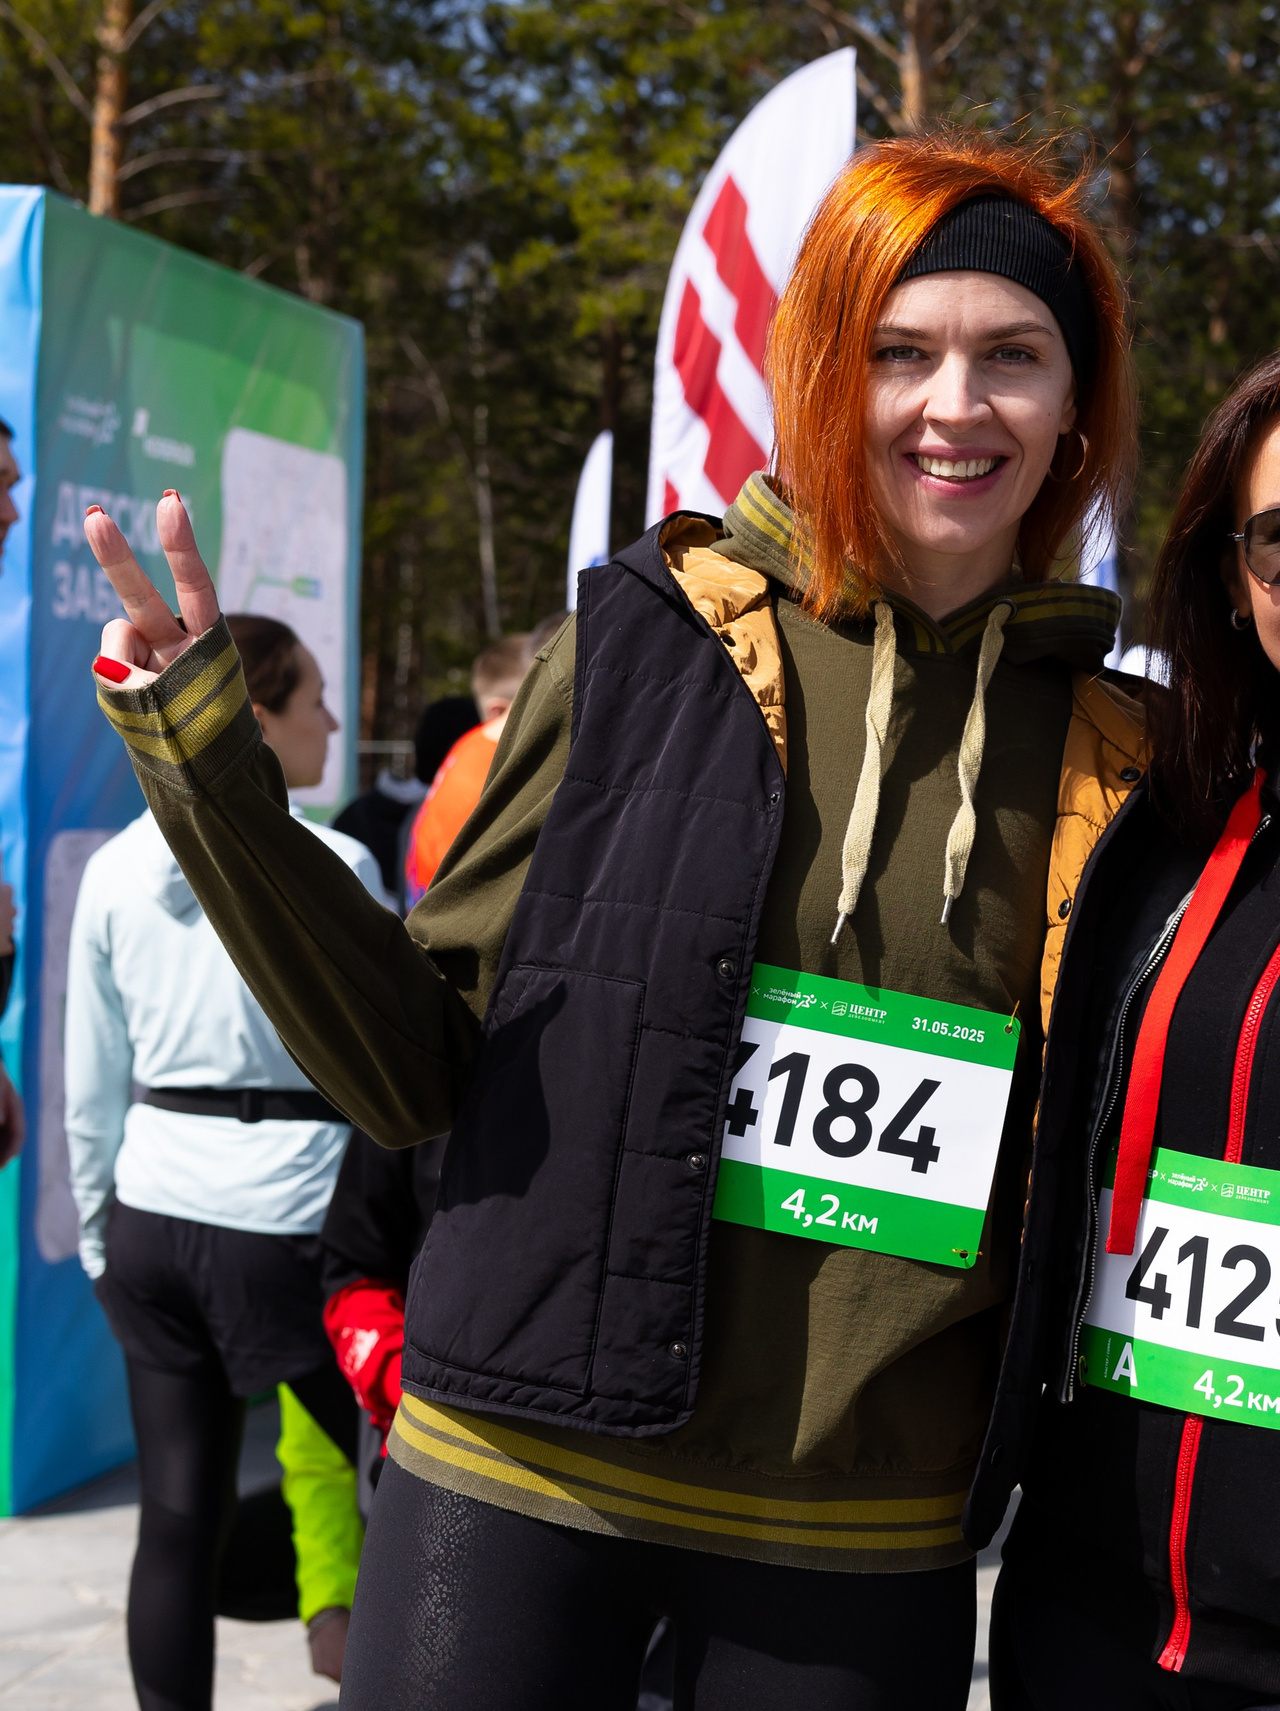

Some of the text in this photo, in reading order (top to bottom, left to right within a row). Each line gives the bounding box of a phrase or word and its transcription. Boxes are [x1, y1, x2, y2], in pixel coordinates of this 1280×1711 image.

[763, 993, 797, 1005] марафон
[849, 1003, 888, 1020] ЦЕНТР
[911, 1016, 986, 1043] 31.05.2025
[725, 1040, 943, 1175] 4184
[1236, 1185, 1271, 1199] ЦЕНТР
[780, 1188, 841, 1228] 4,2
[1193, 1369, 1245, 1408] 4,2
